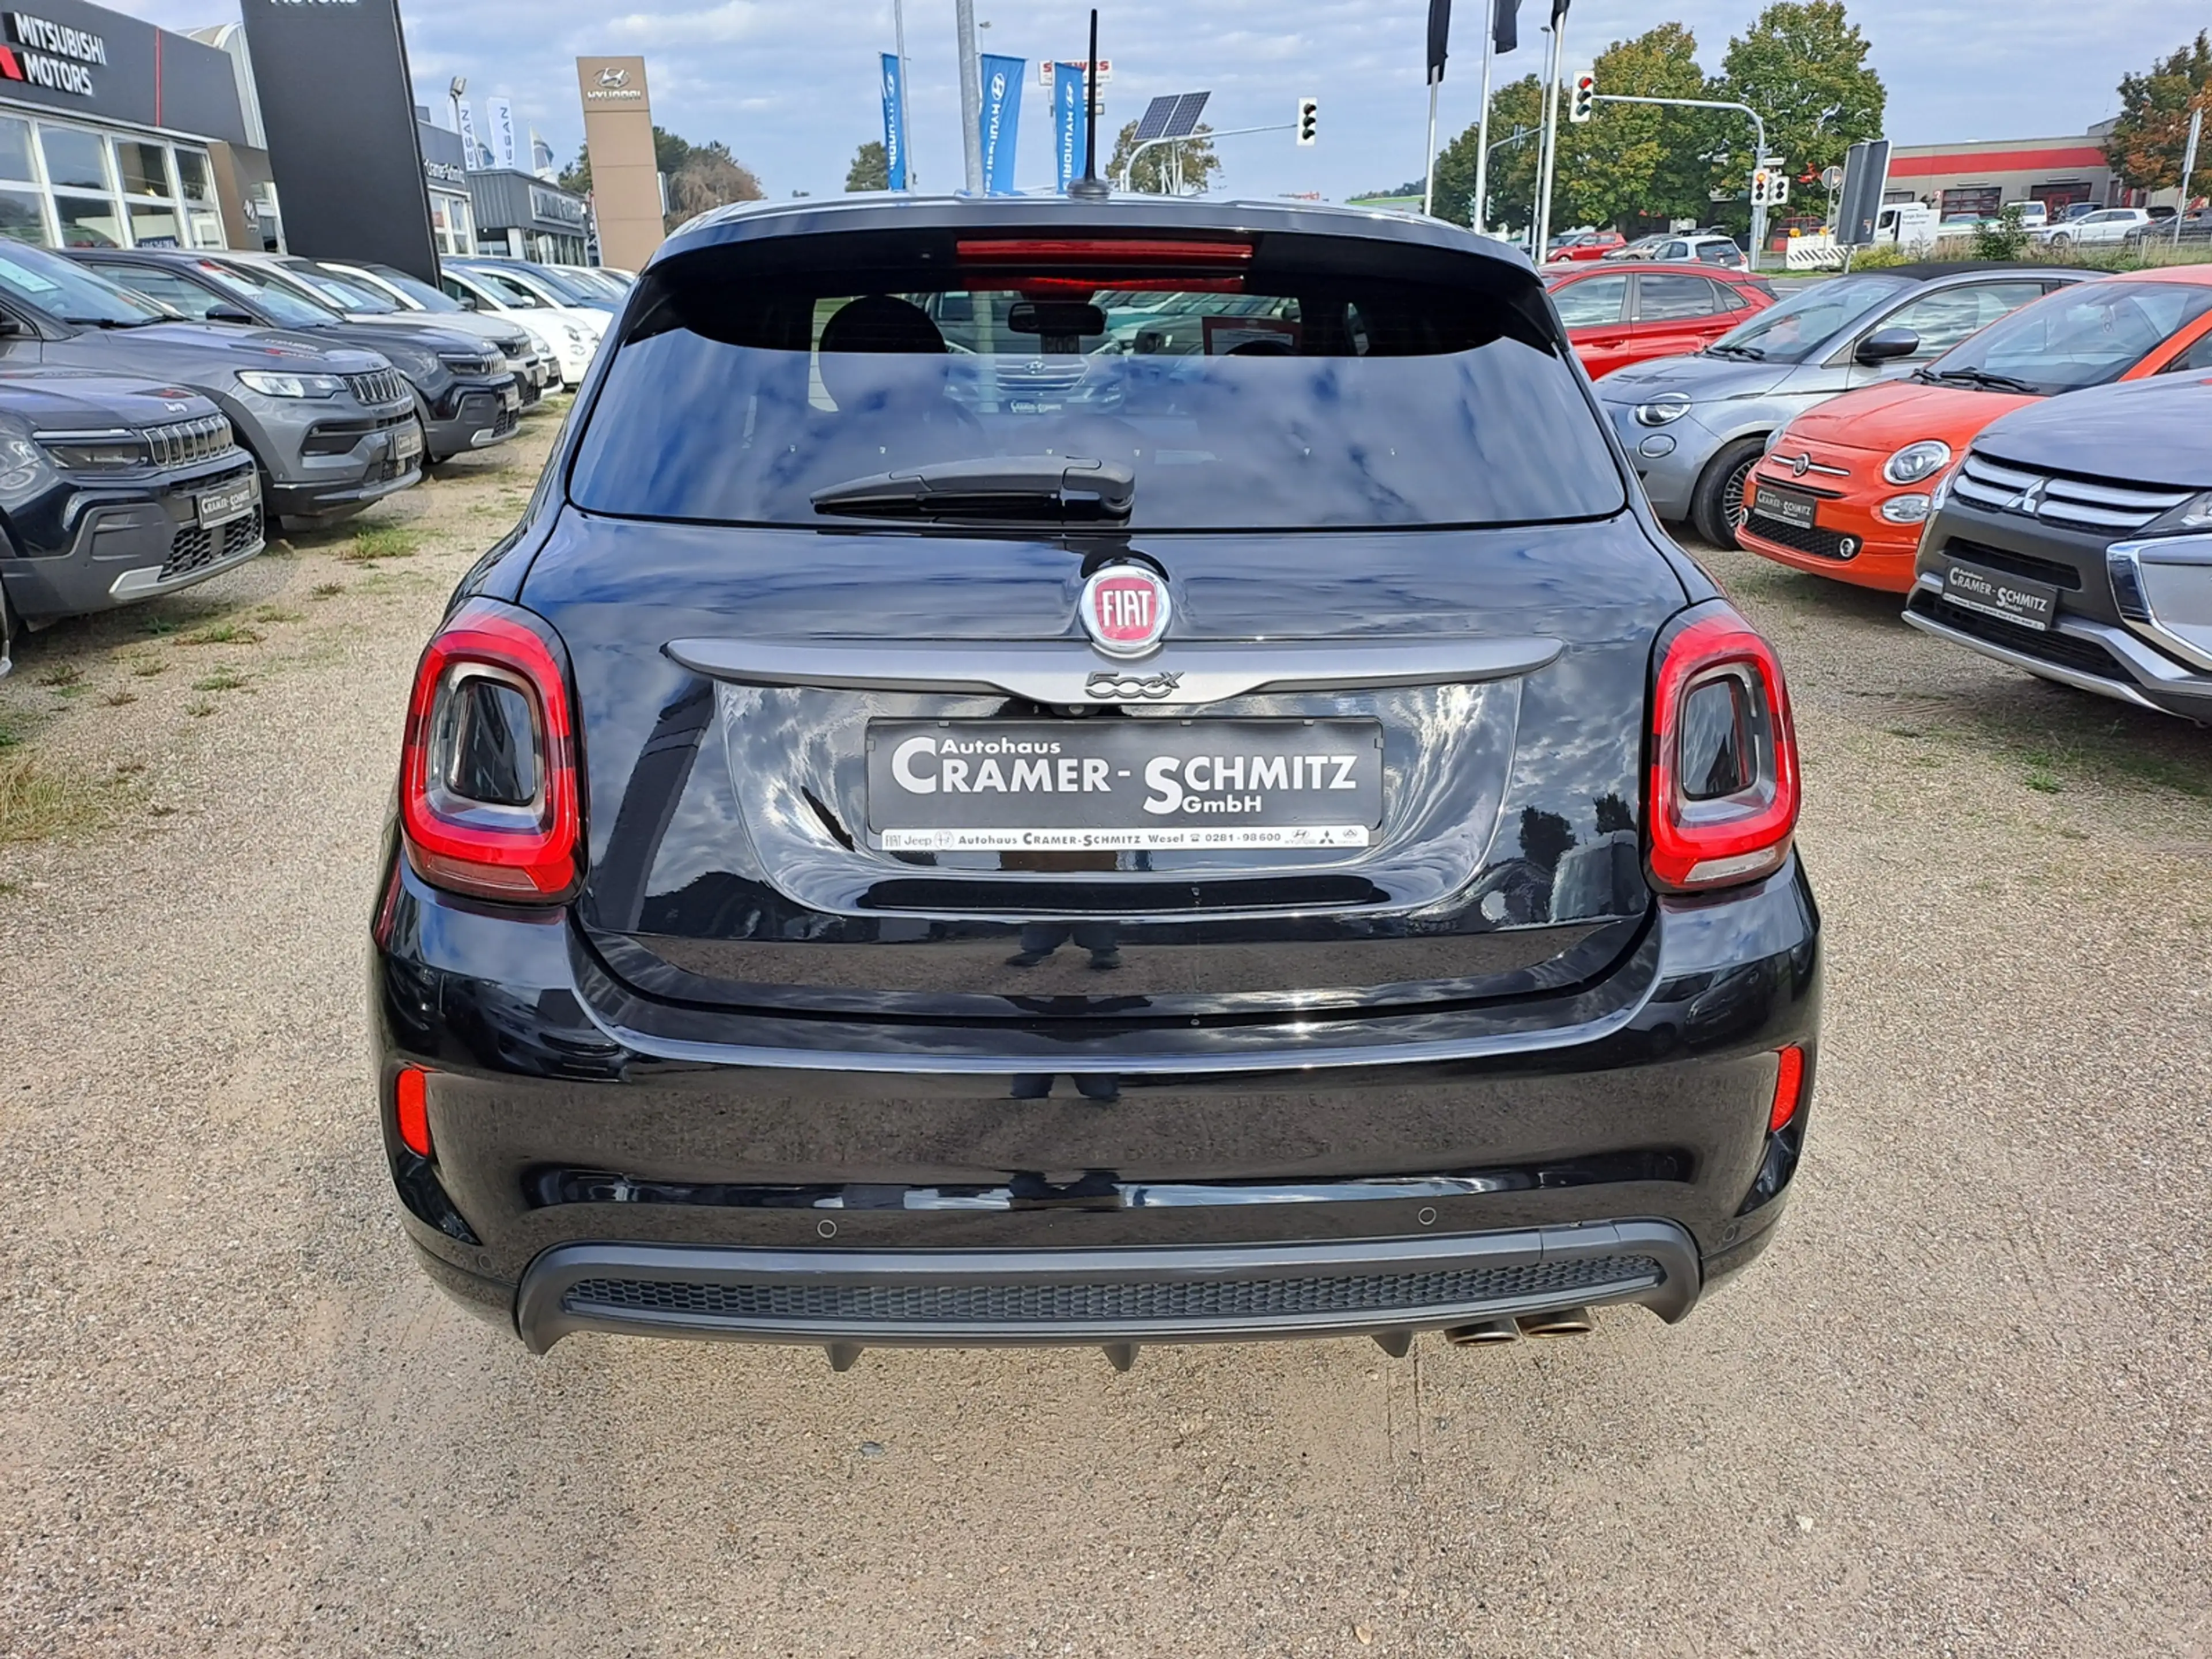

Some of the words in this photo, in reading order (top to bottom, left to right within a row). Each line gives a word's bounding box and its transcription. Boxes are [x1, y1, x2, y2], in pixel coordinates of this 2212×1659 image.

[14, 11, 107, 66] MITSUBISHI
[22, 51, 93, 97] MOTORS
[1063, 112, 1074, 178] HYUNDAI
[1103, 589, 1152, 627] FIAT
[940, 737, 1061, 755] Autohaus
[1181, 795, 1262, 813] GmbH
[904, 835, 932, 847] Jeep
[958, 836, 1017, 844] Autohaus
[1023, 832, 1141, 847] CRAMER-SCHMITZ
[1148, 834, 1184, 843] Wesel
